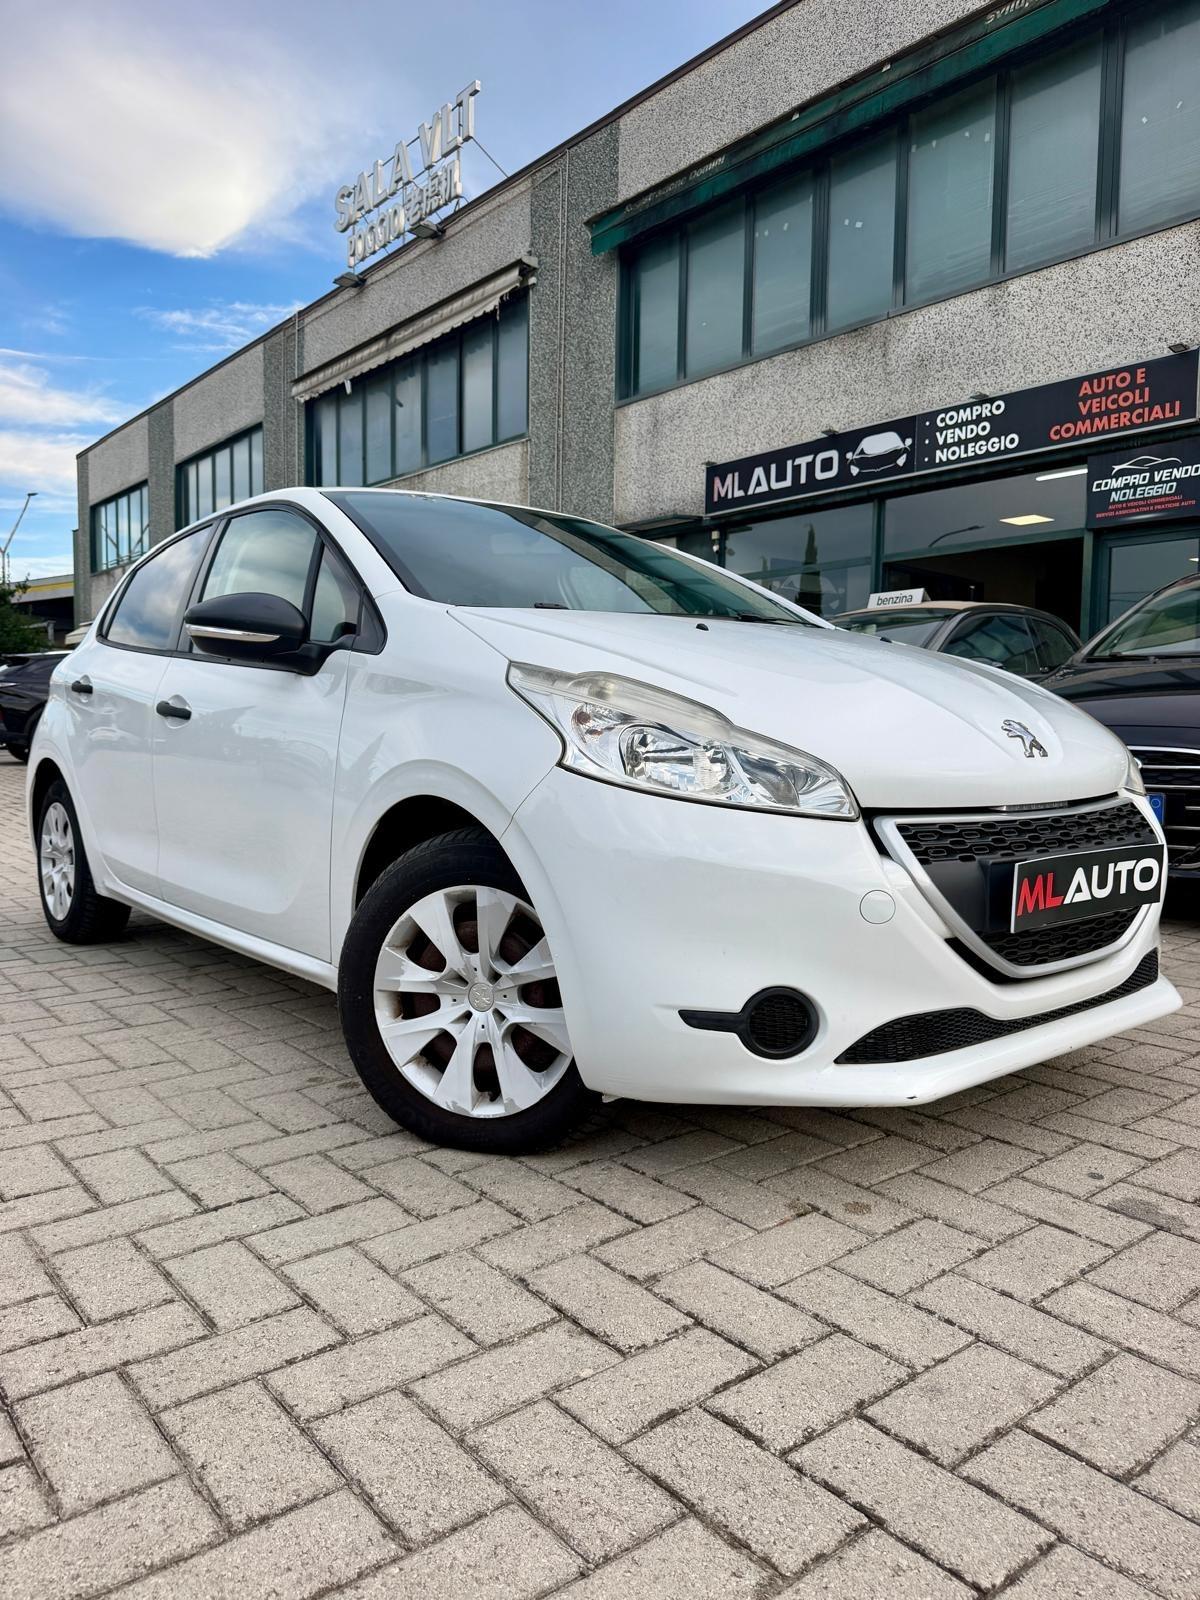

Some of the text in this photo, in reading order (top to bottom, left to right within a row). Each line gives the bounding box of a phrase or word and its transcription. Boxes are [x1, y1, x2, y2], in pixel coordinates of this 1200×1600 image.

[334, 79, 481, 233] SALA VLT
[1078, 367, 1146, 397] AUTO E
[936, 400, 1005, 427] COMPRO
[1078, 387, 1149, 416] VEICOLI
[935, 421, 991, 445] VENDO
[1049, 400, 1181, 441] COMMERCIALI
[935, 433, 1019, 463] NOLEGGIO
[1092, 465, 1200, 492] COMPRO VENDO
[1110, 482, 1176, 502] NOLEGGIO
[876, 594, 913, 606] benzina
